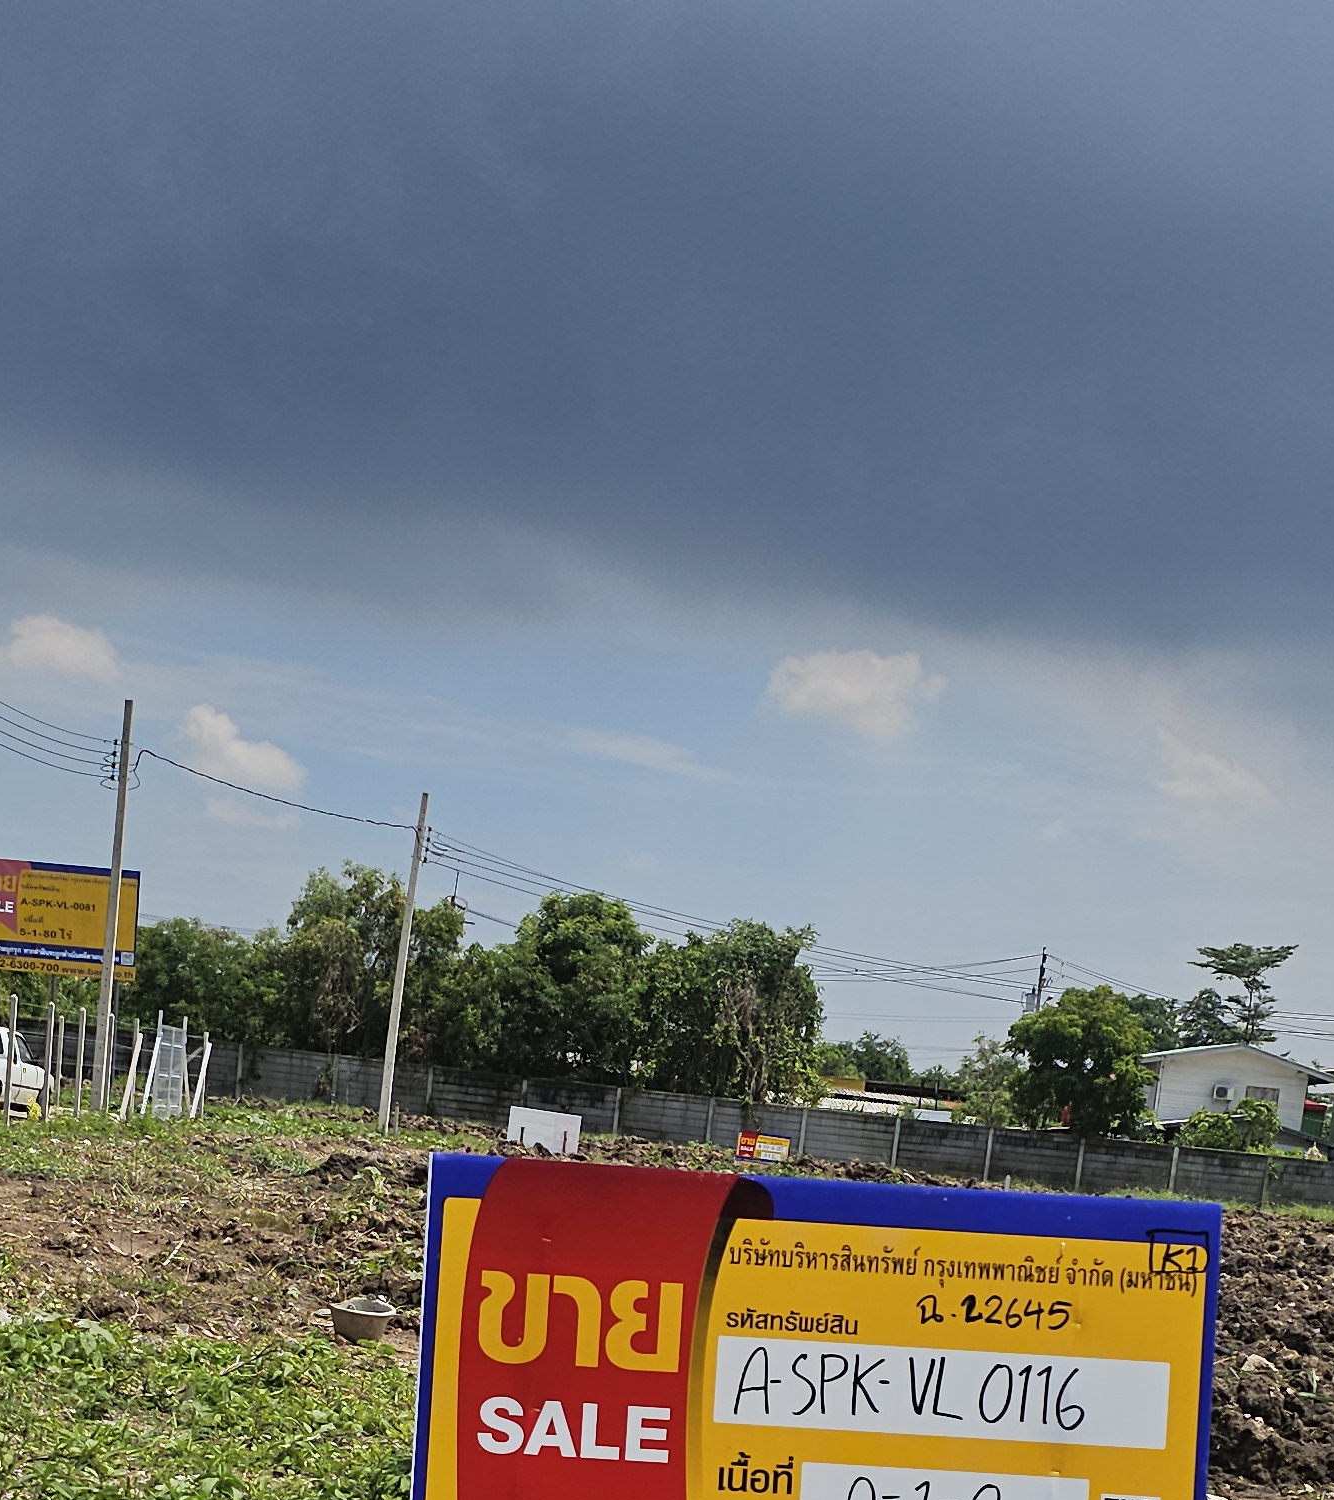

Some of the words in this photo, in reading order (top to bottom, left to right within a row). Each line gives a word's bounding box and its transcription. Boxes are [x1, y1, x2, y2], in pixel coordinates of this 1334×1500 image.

[729, 1238, 921, 1276] บริษัทบริหารสินทรัพย์
[923, 1254, 1064, 1288] กรุงเทพพาณิชย์
[1066, 1257, 1114, 1288] จำกัด
[478, 1269, 684, 1373] ขาย
[725, 1307, 859, 1336] รหัสทรัพย์สิน
[978, 1363, 1086, 1431] 0116
[476, 1396, 671, 1464] SALE
[717, 1451, 794, 1496] เนื้อที่
